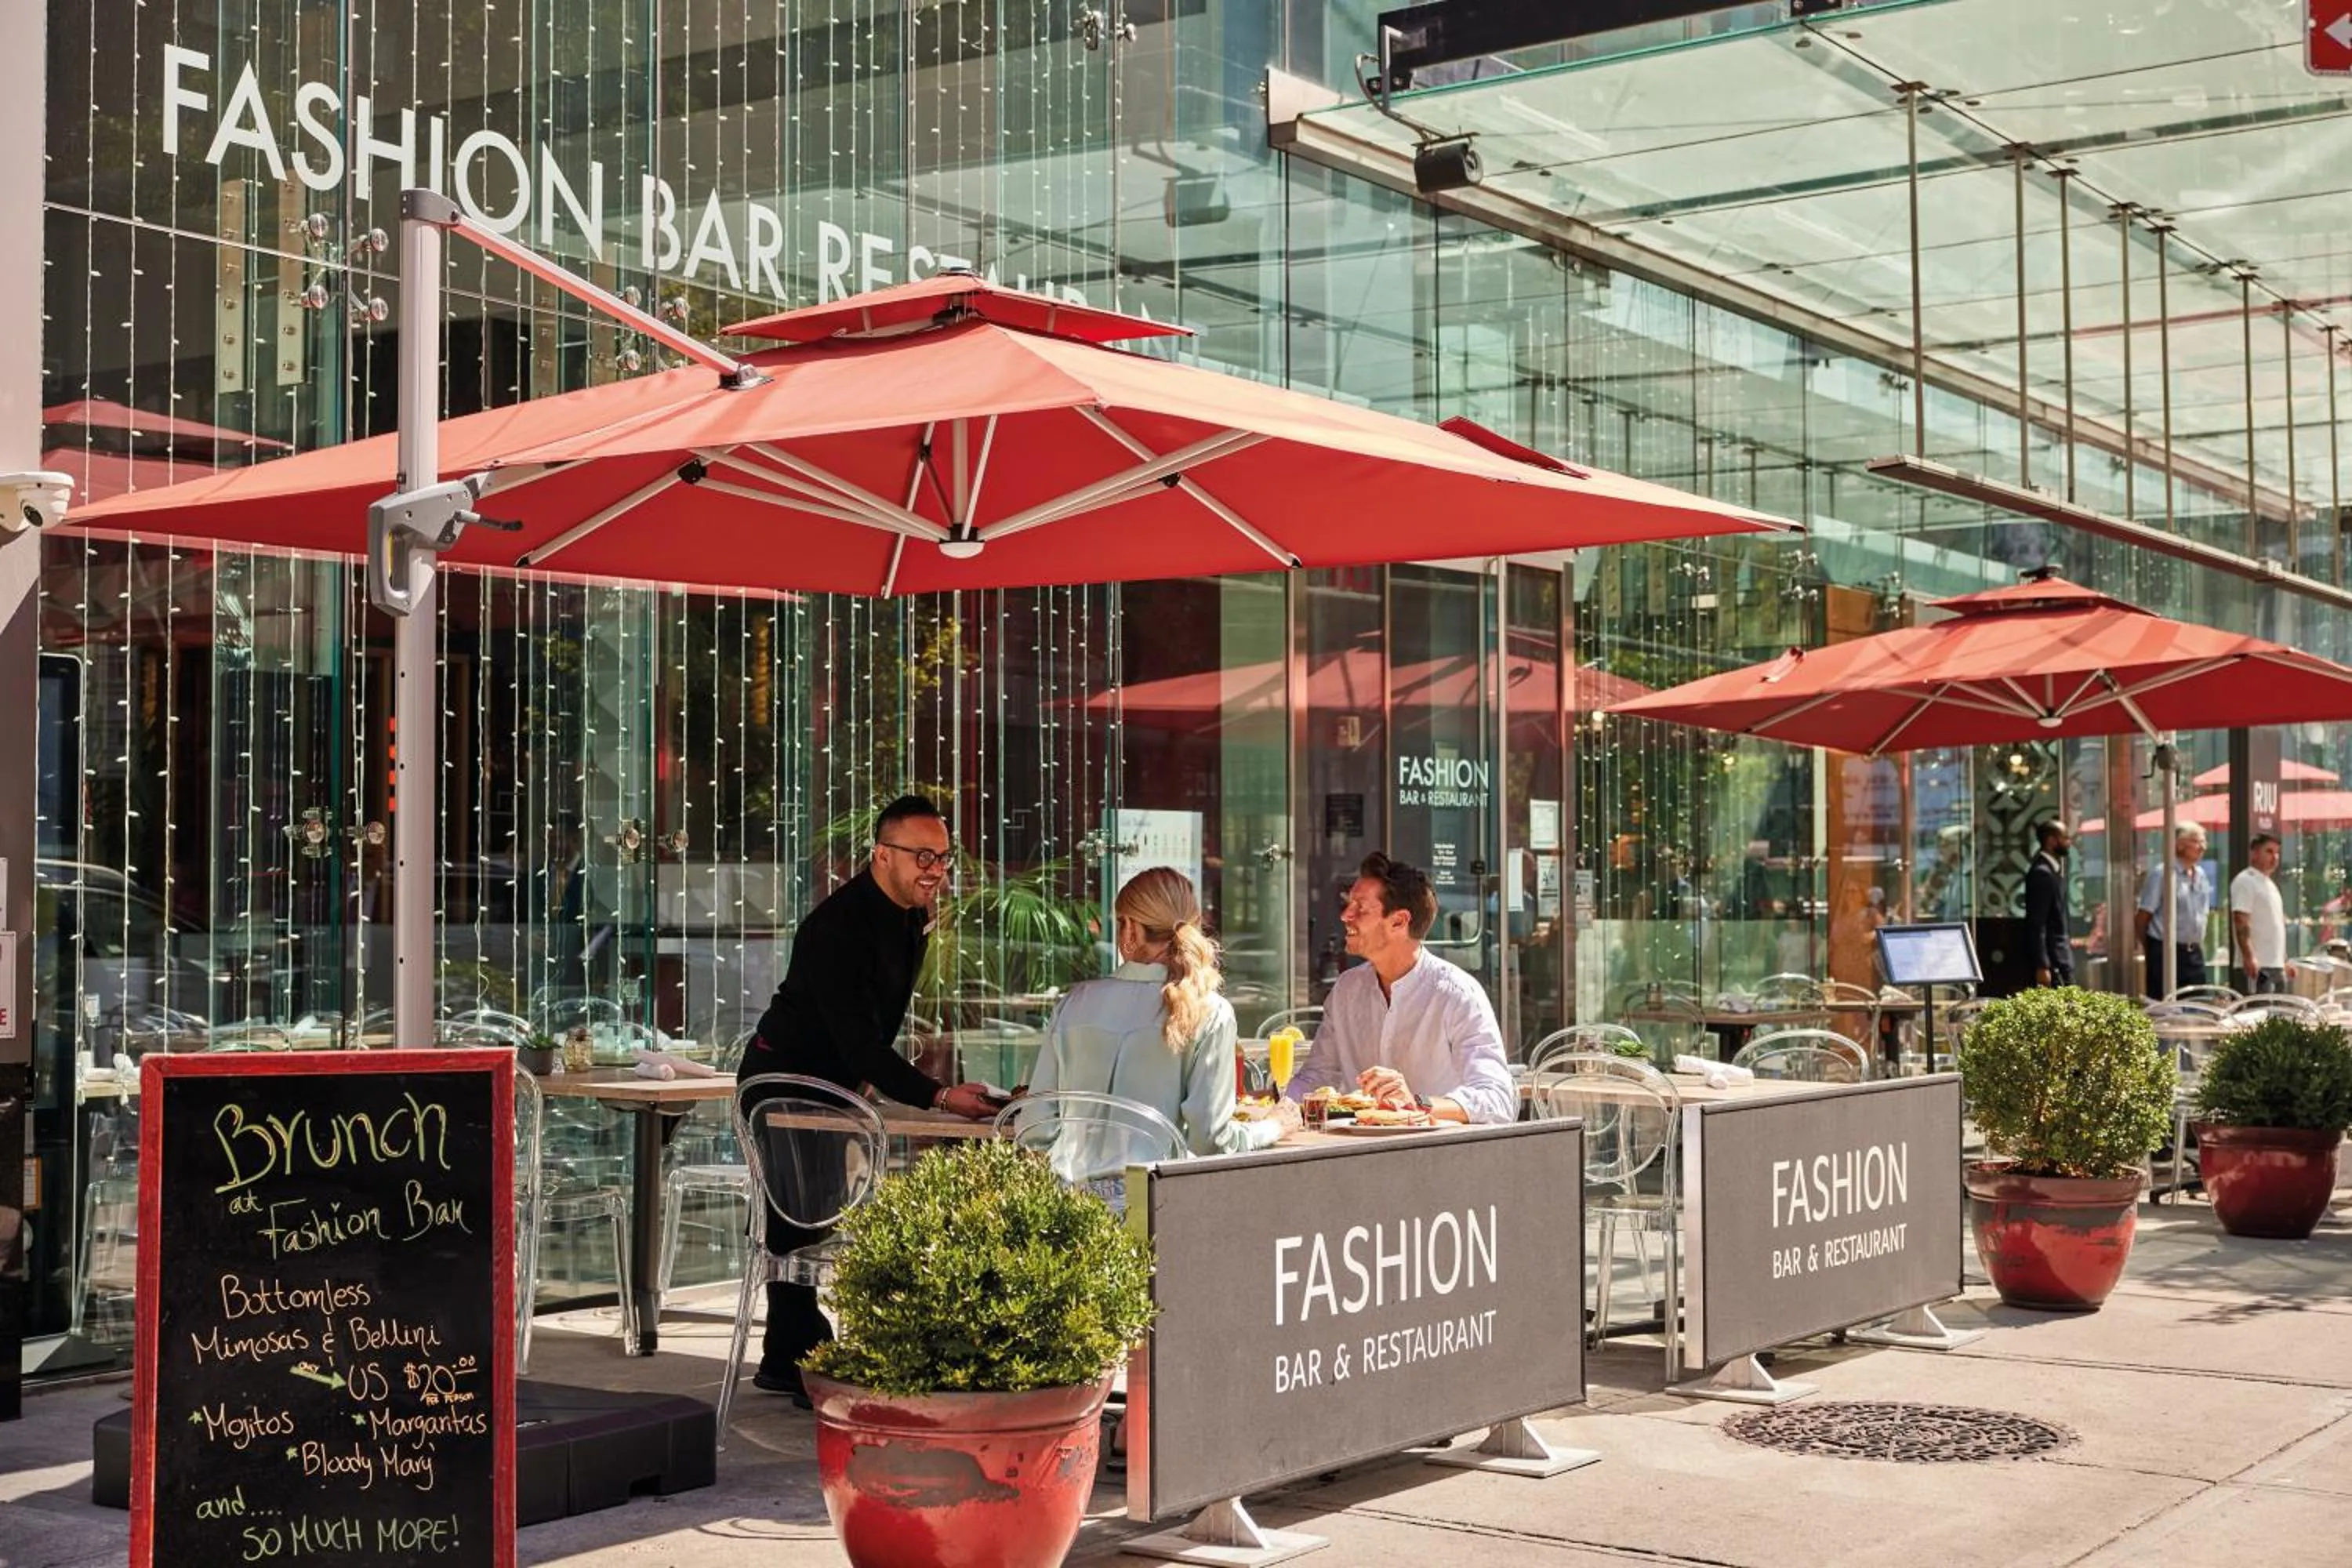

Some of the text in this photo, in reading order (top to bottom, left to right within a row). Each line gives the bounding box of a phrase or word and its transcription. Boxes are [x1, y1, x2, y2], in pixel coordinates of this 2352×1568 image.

[162, 43, 604, 263] FASHION
[641, 173, 787, 301] BAR
[1399, 756, 1489, 789] FASHION
[2253, 780, 2278, 813] RIU
[1399, 789, 1419, 805] BAR
[1428, 790, 1488, 807] RESTAURANT
[213, 1091, 452, 1195] Brunch
[228, 1189, 263, 1215] at
[1773, 1141, 1907, 1229] FASHION
[257, 1179, 473, 1260] Fashion Bar
[1275, 1204, 1497, 1326] FASHION
[1773, 1223, 1907, 1279] BAR & RESTAURANT
[220, 1274, 372, 1320] Bottomless
[191, 1326, 310, 1364] Mimosas
[347, 1316, 443, 1357] Bellini
[1275, 1310, 1497, 1393] BAR & RESTAURANT
[347, 1362, 389, 1402] US
[201, 1402, 296, 1450] Mojitos
[301, 1441, 372, 1490] Bloody
[241, 1514, 461, 1562] SO MUCH MORE!
